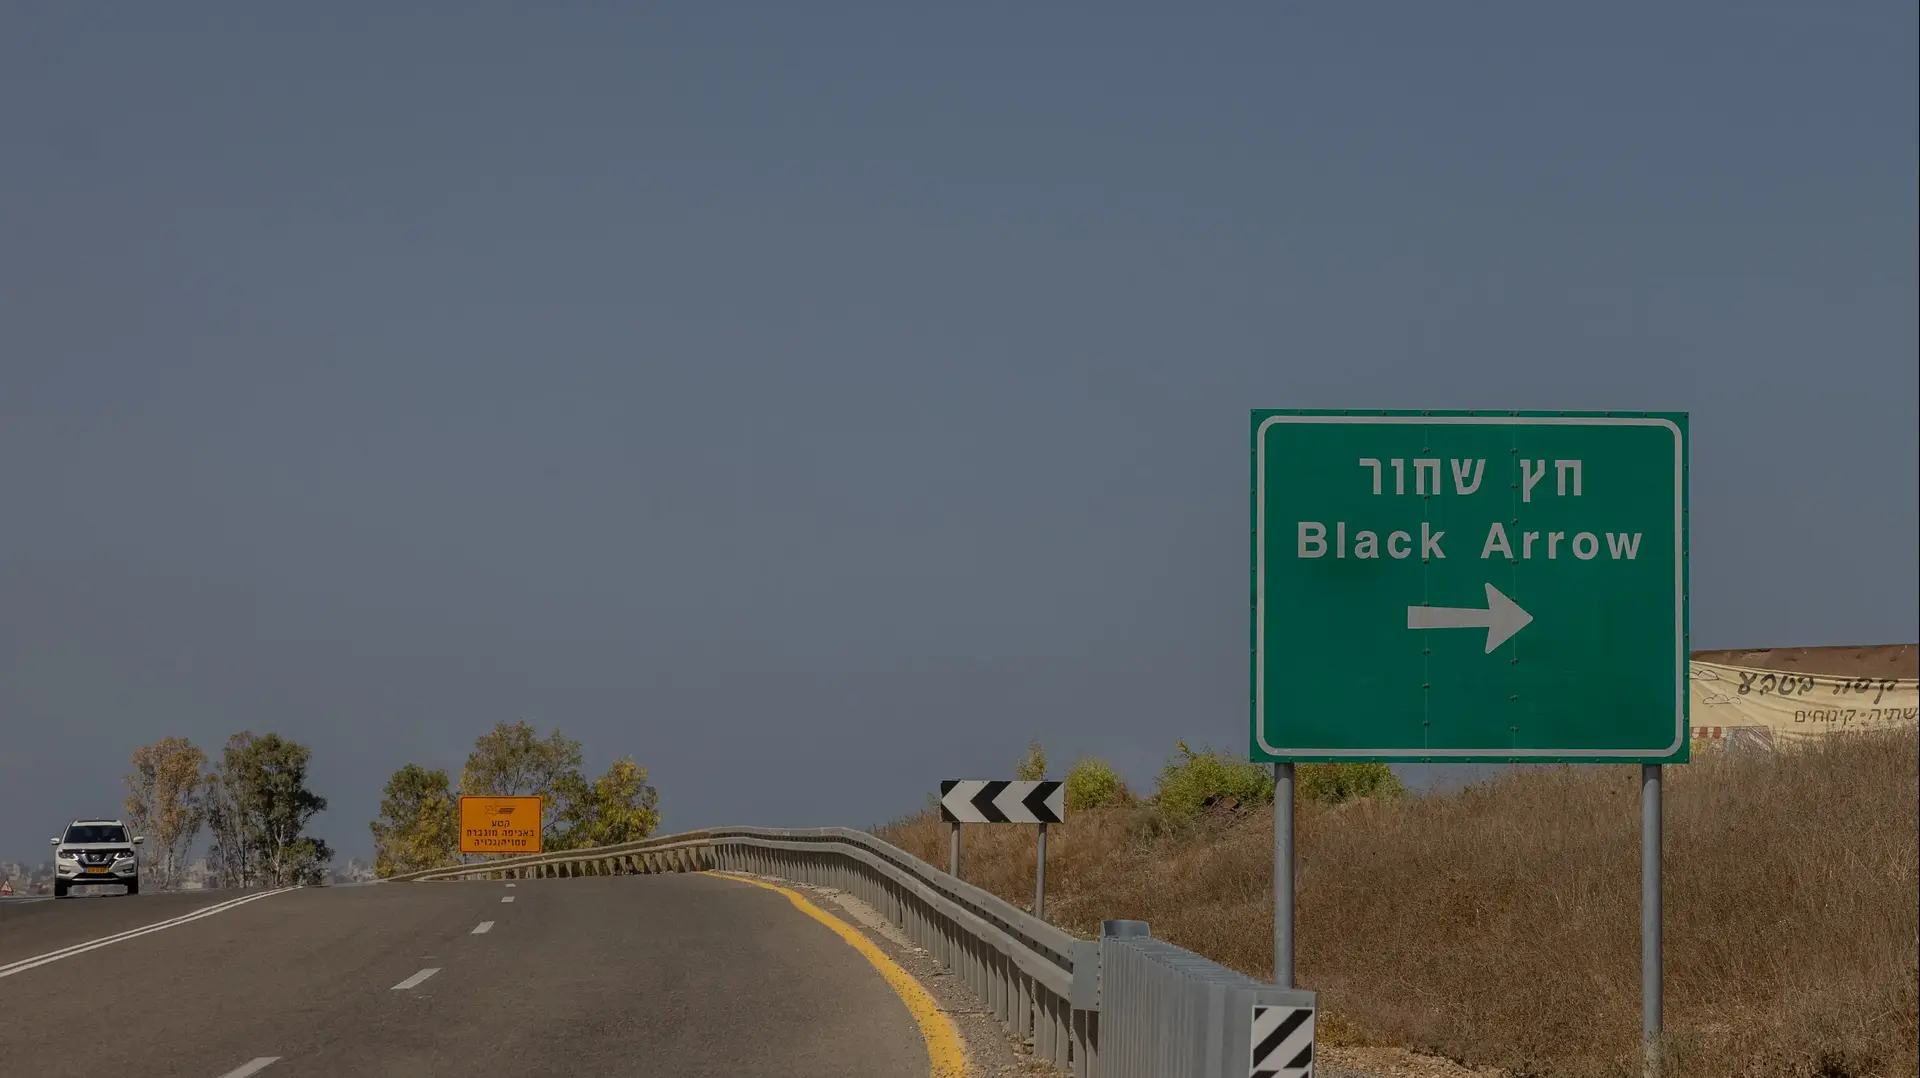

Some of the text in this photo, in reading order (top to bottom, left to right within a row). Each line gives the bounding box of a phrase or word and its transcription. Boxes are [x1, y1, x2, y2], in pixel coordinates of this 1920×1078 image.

[1359, 458, 1582, 503] חץ שחור
[1297, 521, 1642, 560] Black Arrow
[1737, 671, 1815, 696] בטבע
[491, 820, 510, 829] קטע
